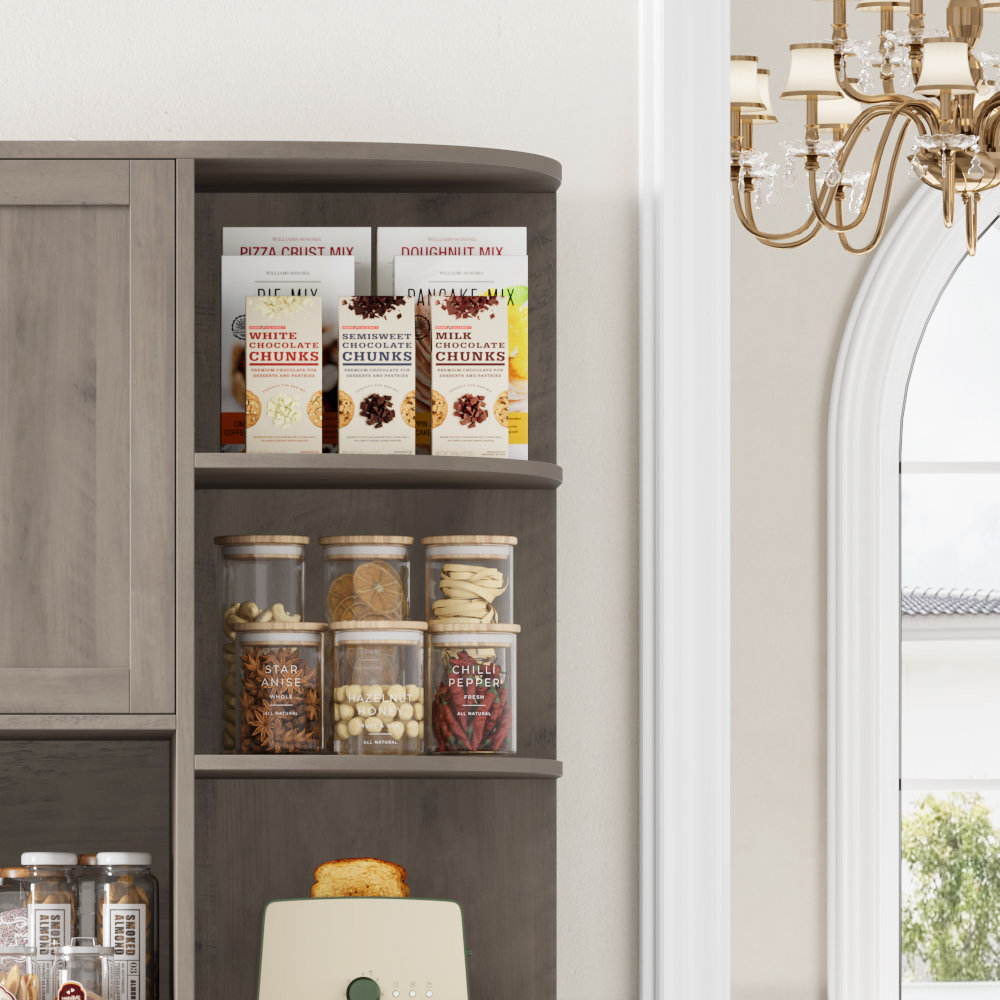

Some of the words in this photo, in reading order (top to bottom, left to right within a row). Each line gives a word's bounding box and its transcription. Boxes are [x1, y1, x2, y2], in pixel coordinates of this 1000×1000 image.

[249, 332, 297, 340] WHITE
[435, 332, 472, 340] MILK
[249, 351, 319, 362] CHUNKS
[342, 351, 412, 362] CHUNKS
[435, 351, 505, 362] CHUNKS
[265, 665, 298, 674] STAR
[452, 665, 496, 674] CHILLI
[261, 678, 301, 687] ANISE
[448, 678, 500, 687] PEPPER
[348, 693, 413, 703] HAZELNUT
[358, 706, 403, 716] HONEY
[40, 915, 49, 955] ALMOND
[115, 915, 124, 955] ALMOND
[126, 915, 136, 955] SMOKED
[130, 962, 137, 974] 03
